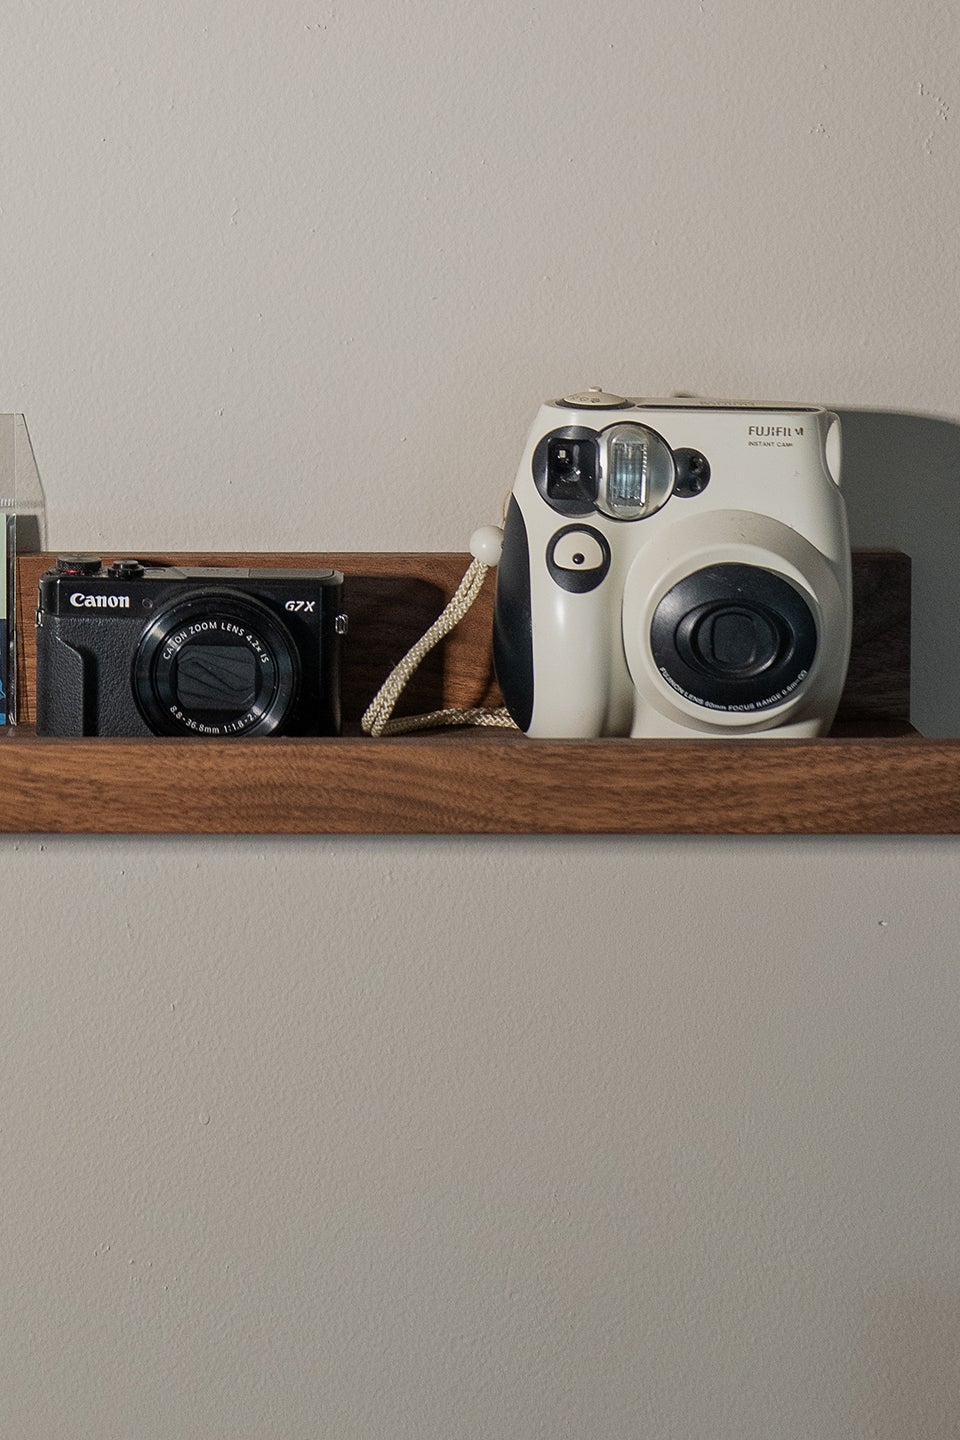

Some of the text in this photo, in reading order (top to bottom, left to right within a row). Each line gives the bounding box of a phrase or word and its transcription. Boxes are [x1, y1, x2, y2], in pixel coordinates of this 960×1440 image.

[748, 426, 804, 437] FUJIFILM
[70, 593, 130, 608] Canon
[189, 621, 217, 635] ZOOM
[221, 622, 245, 637] LENS
[260, 653, 270, 664] IS
[755, 693, 782, 708] RANGE
